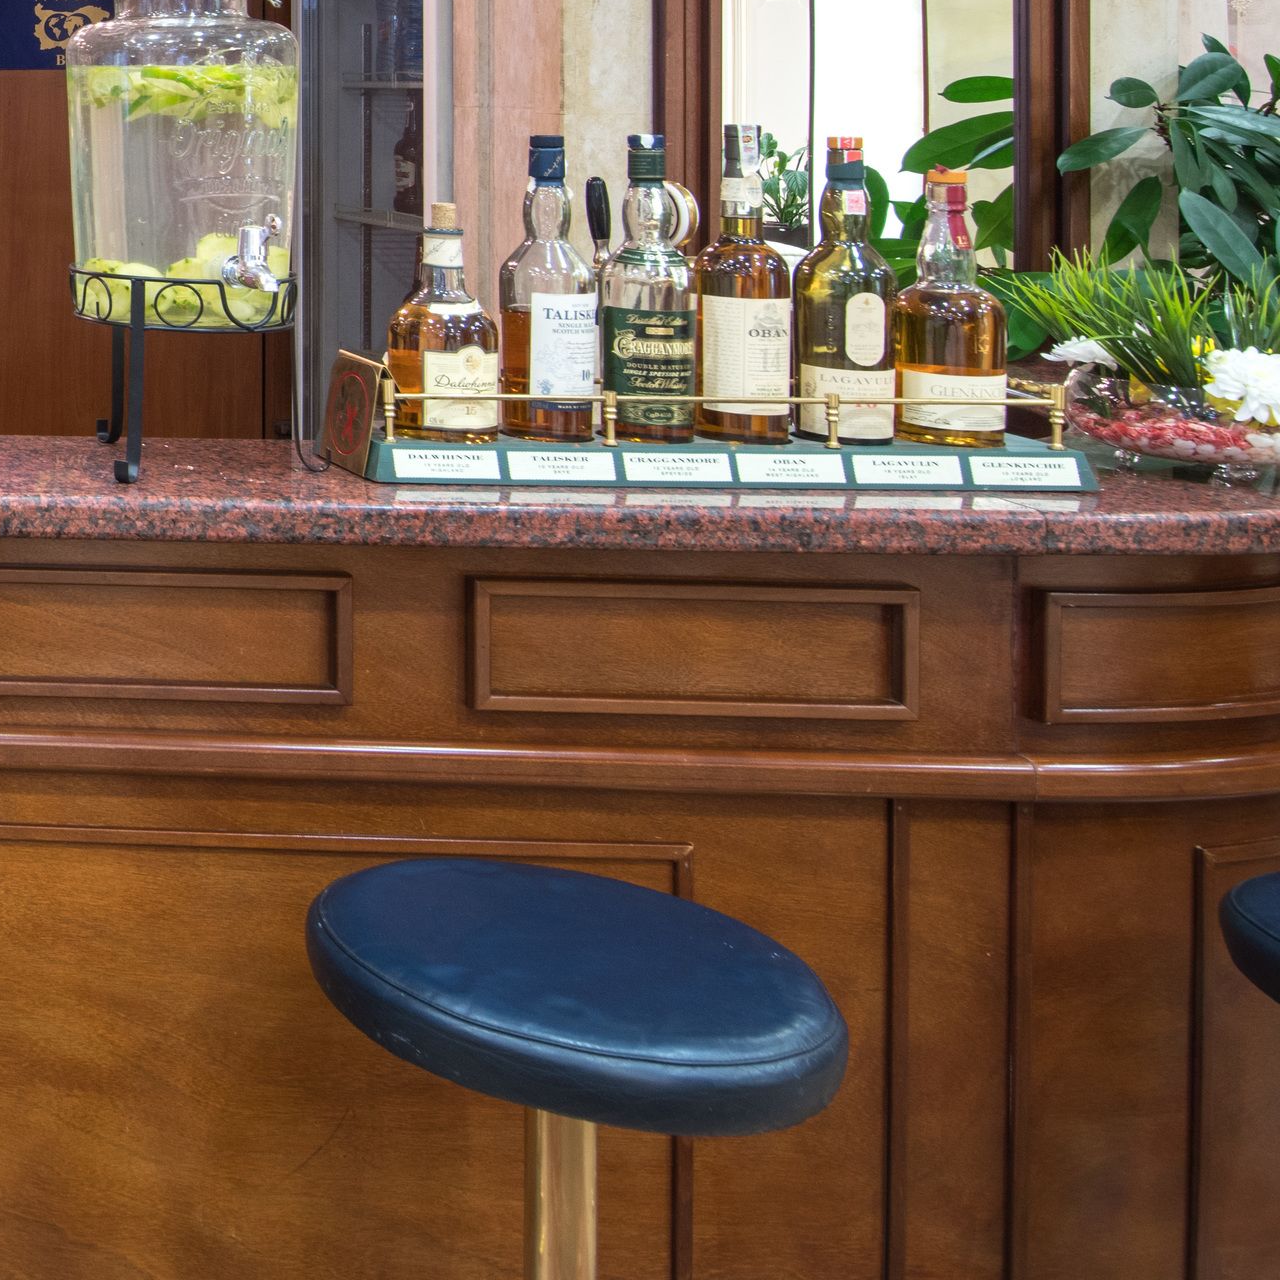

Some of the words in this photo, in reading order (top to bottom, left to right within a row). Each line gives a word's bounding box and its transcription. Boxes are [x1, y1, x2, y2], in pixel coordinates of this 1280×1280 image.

[748, 328, 789, 339] OBAN
[612, 334, 694, 359] CRAGGANMORE
[626, 362, 659, 370] DOUBLE
[581, 369, 591, 382] 10
[623, 368, 647, 376] SINGLE
[464, 405, 477, 416] 15
[408, 453, 483, 461] DALWHINNIE
[531, 455, 590, 463] TALISKER
[629, 456, 721, 465] CRAGGANMORE
[871, 460, 940, 468] LAGAVULIN
[981, 461, 1065, 470] GLENKINCHIE
